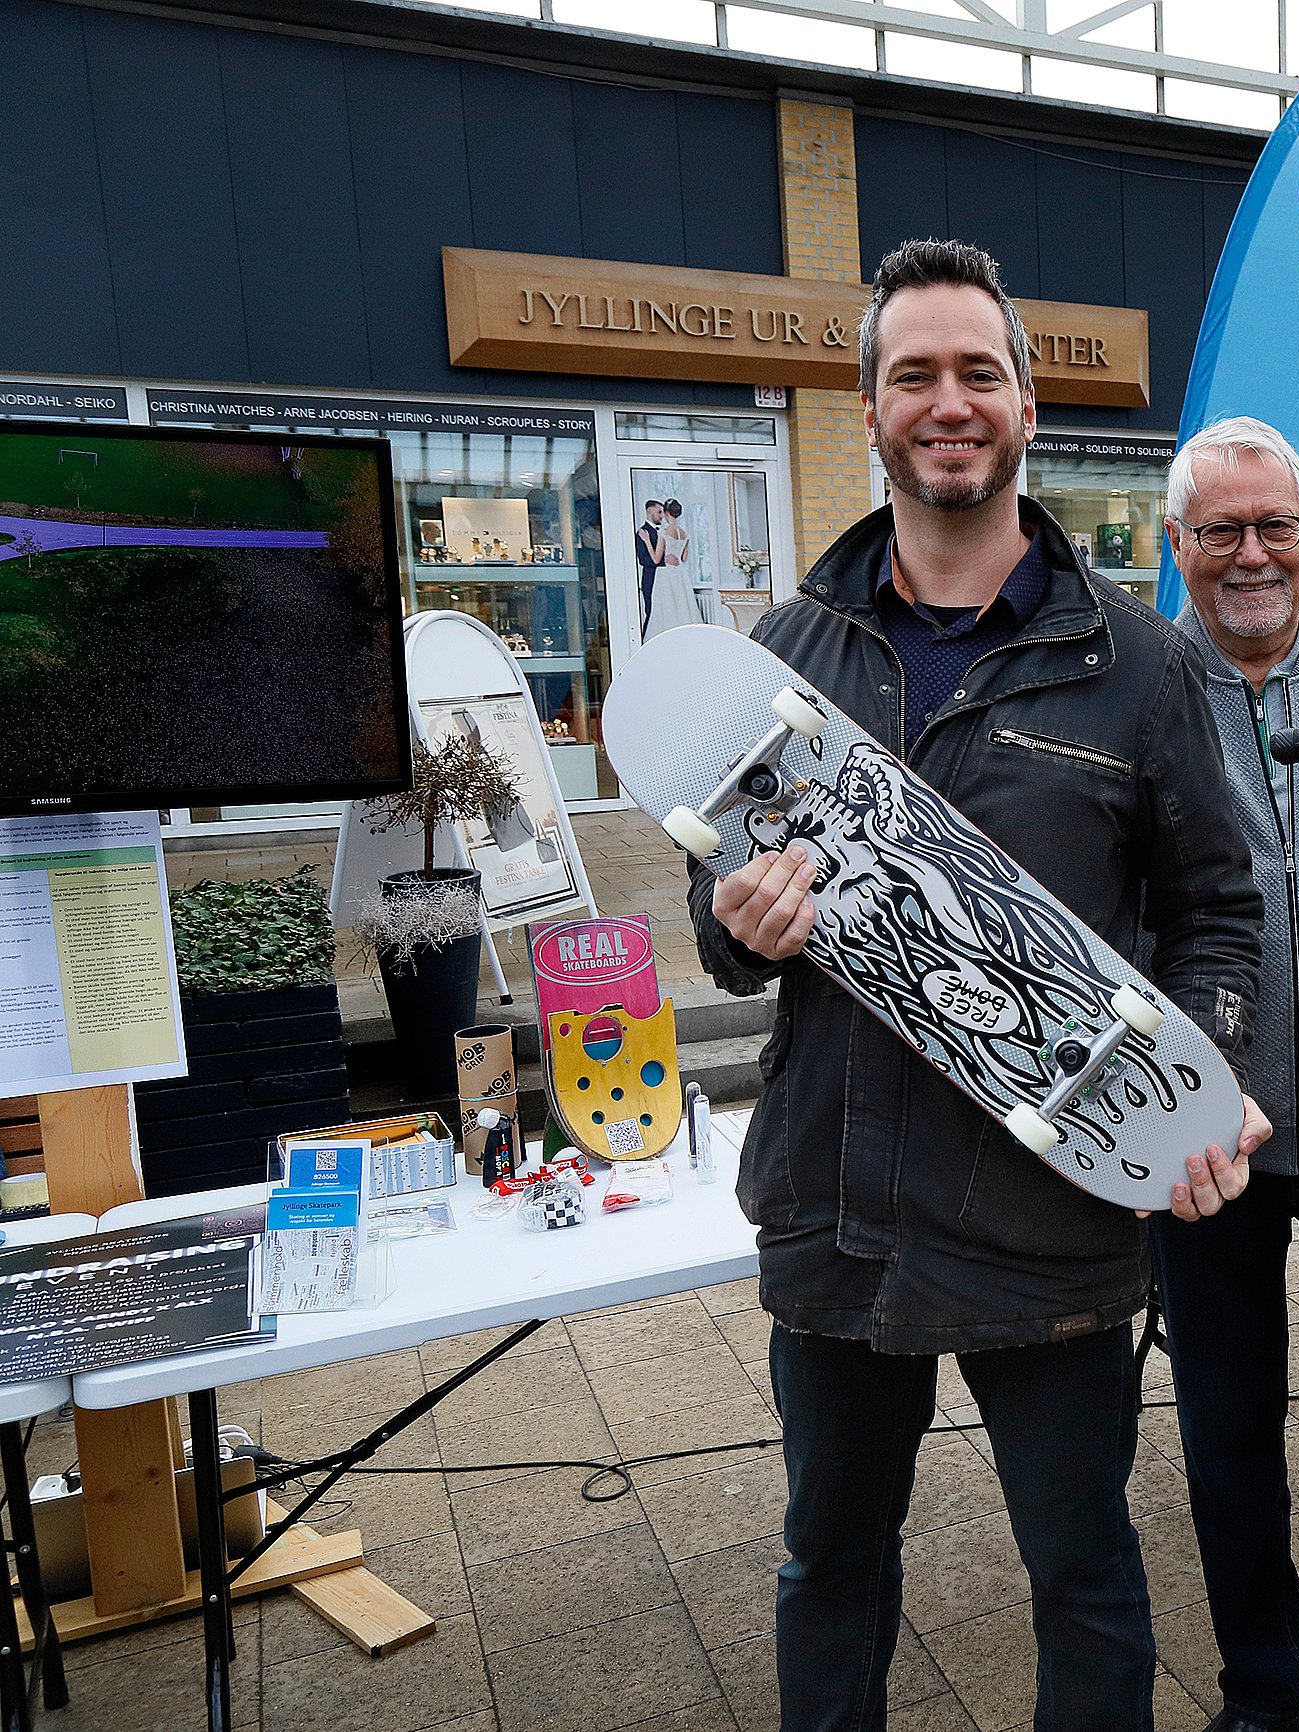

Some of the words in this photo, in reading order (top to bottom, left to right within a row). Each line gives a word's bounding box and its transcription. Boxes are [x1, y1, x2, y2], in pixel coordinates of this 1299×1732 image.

[518, 288, 736, 339] JYLLINGE
[748, 307, 809, 345] UR
[822, 316, 849, 348] &
[758, 386, 771, 399] 12
[774, 387, 783, 400] B
[74, 397, 116, 409] SEIKO
[150, 401, 216, 414] CHRISTINA
[216, 404, 275, 417] WATCHES
[284, 407, 316, 419] ARNE
[318, 408, 379, 421] JACOBSEN
[387, 411, 433, 424] HEIRING
[441, 414, 479, 426] NURAN
[487, 416, 550, 429] SCROUPLES
[558, 419, 592, 430] STORY
[1027, 442, 1059, 451] JOANLI
[1060, 443, 1079, 452] NOR
[1086, 444, 1123, 455] SOLDIER
[1123, 446, 1136, 455] TO
[1136, 447, 1173, 457] SOLDIER
[493, 711, 519, 721] FESTINA
[31, 797, 71, 805] SAMSUNG
[504, 860, 530, 873] GRATIS
[495, 871, 524, 886] FESTINA
[557, 931, 629, 962] REAL
[562, 957, 627, 972] SKATEBOARDS
[936, 991, 1000, 1029] FREE
[457, 1042, 486, 1068] MOB
[461, 1108, 478, 1125] OB
[313, 1173, 338, 1181] 826500
[282, 1202, 307, 1211] Jyllinge
[308, 1201, 342, 1209] Skatepark
[0, 1239, 246, 1284] NDRAISING
[16, 1263, 158, 1291] EVENT
